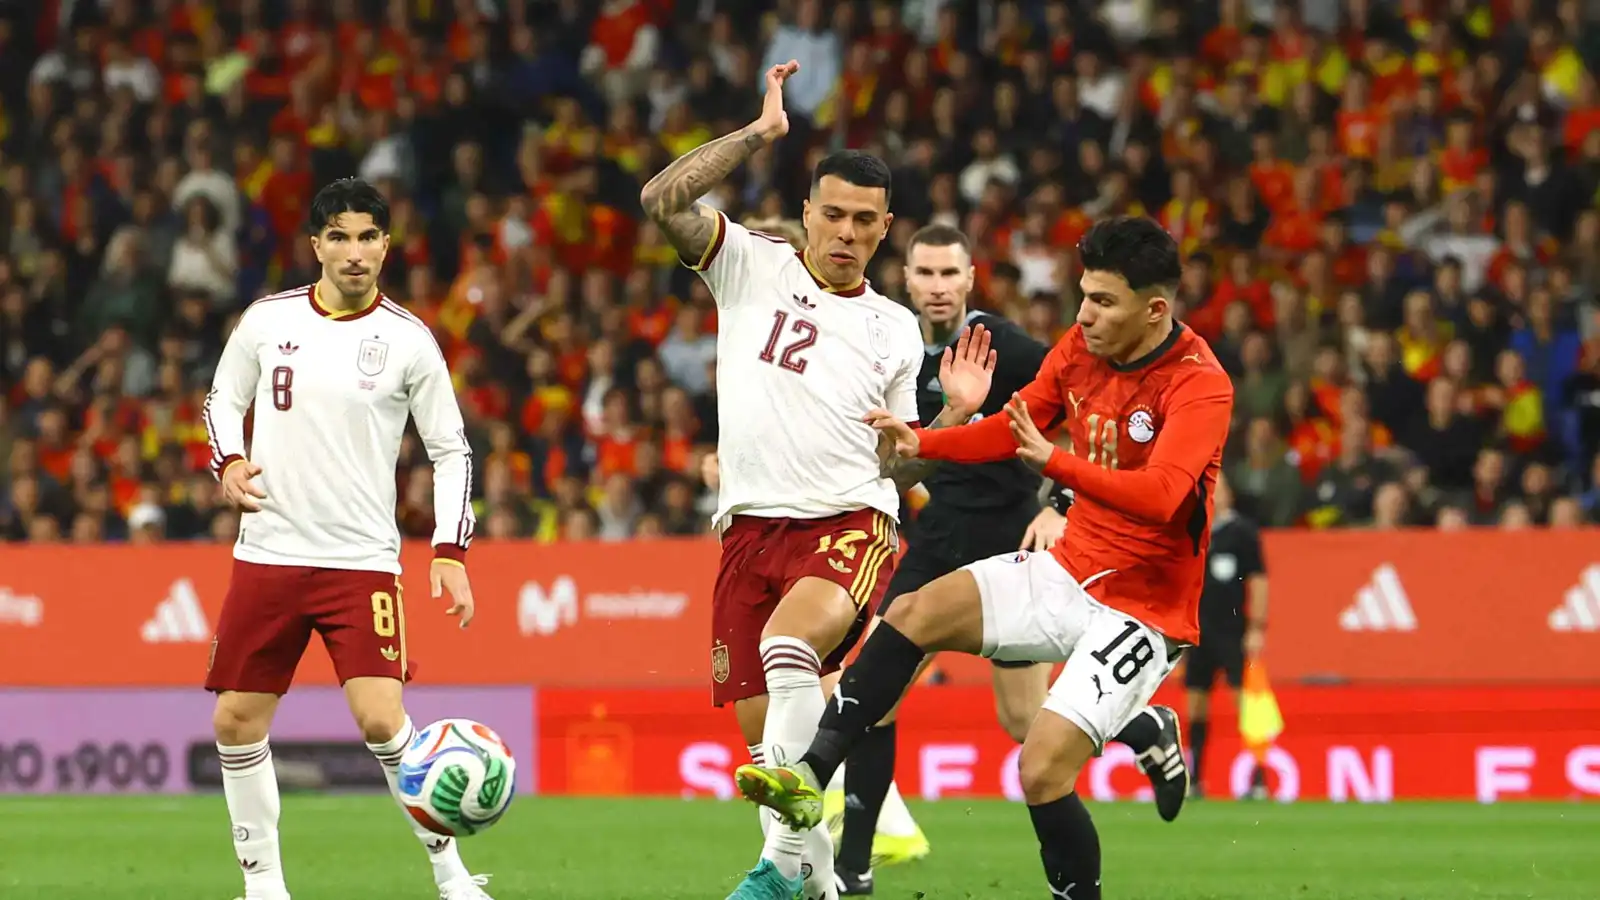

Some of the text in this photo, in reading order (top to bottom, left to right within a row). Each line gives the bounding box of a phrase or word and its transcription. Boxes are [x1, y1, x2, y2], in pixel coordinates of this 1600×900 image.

[759, 309, 819, 376] 12
[271, 366, 294, 412] 8
[1086, 413, 1119, 471] 18
[814, 529, 870, 560] 12
[371, 592, 395, 638] 8
[1091, 619, 1155, 686] 18
